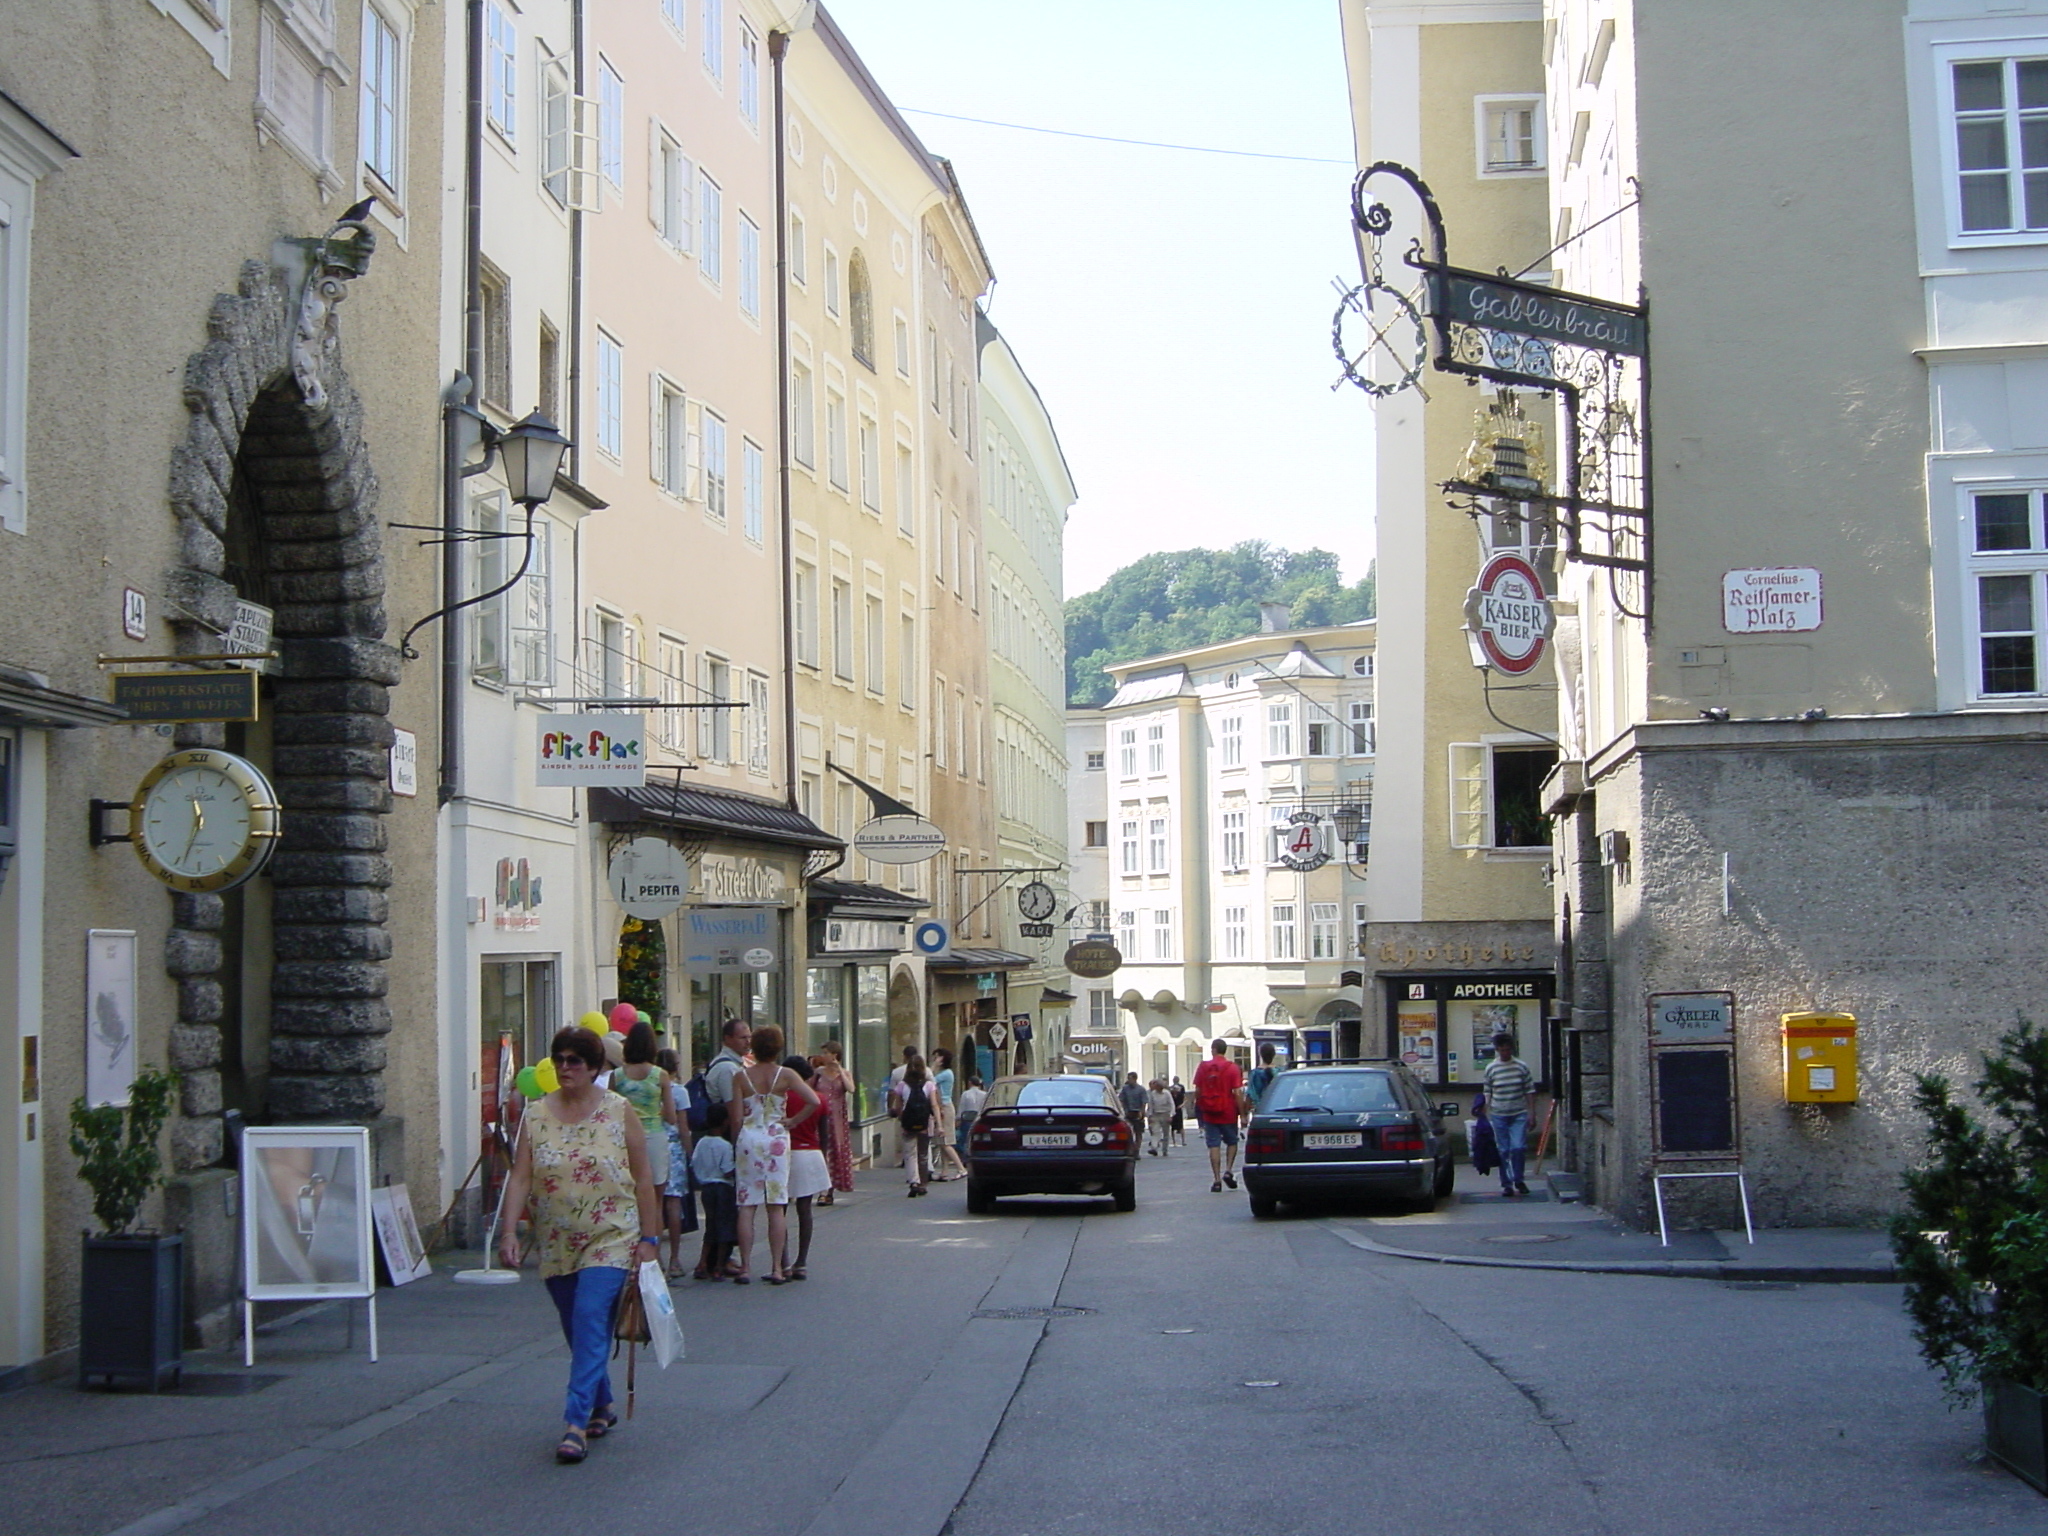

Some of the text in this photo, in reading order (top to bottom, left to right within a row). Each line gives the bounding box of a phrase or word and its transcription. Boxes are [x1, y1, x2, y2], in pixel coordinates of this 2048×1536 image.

[1743, 573, 1805, 586] Cornelius-
[131, 593, 143, 623] 14
[1485, 598, 1543, 630] KAISER
[1747, 608, 1796, 629] Platz
[1500, 623, 1531, 640] BIER
[188, 753, 210, 763] XII
[715, 861, 775, 899] Street One
[639, 885, 680, 896] PEPITA
[1022, 925, 1051, 936] KARL
[1379, 941, 1535, 968] Apotheke
[1454, 984, 1533, 998] APOTHEKE
[1071, 1043, 1109, 1056] Optik
[1310, 1136, 1316, 1145] S
